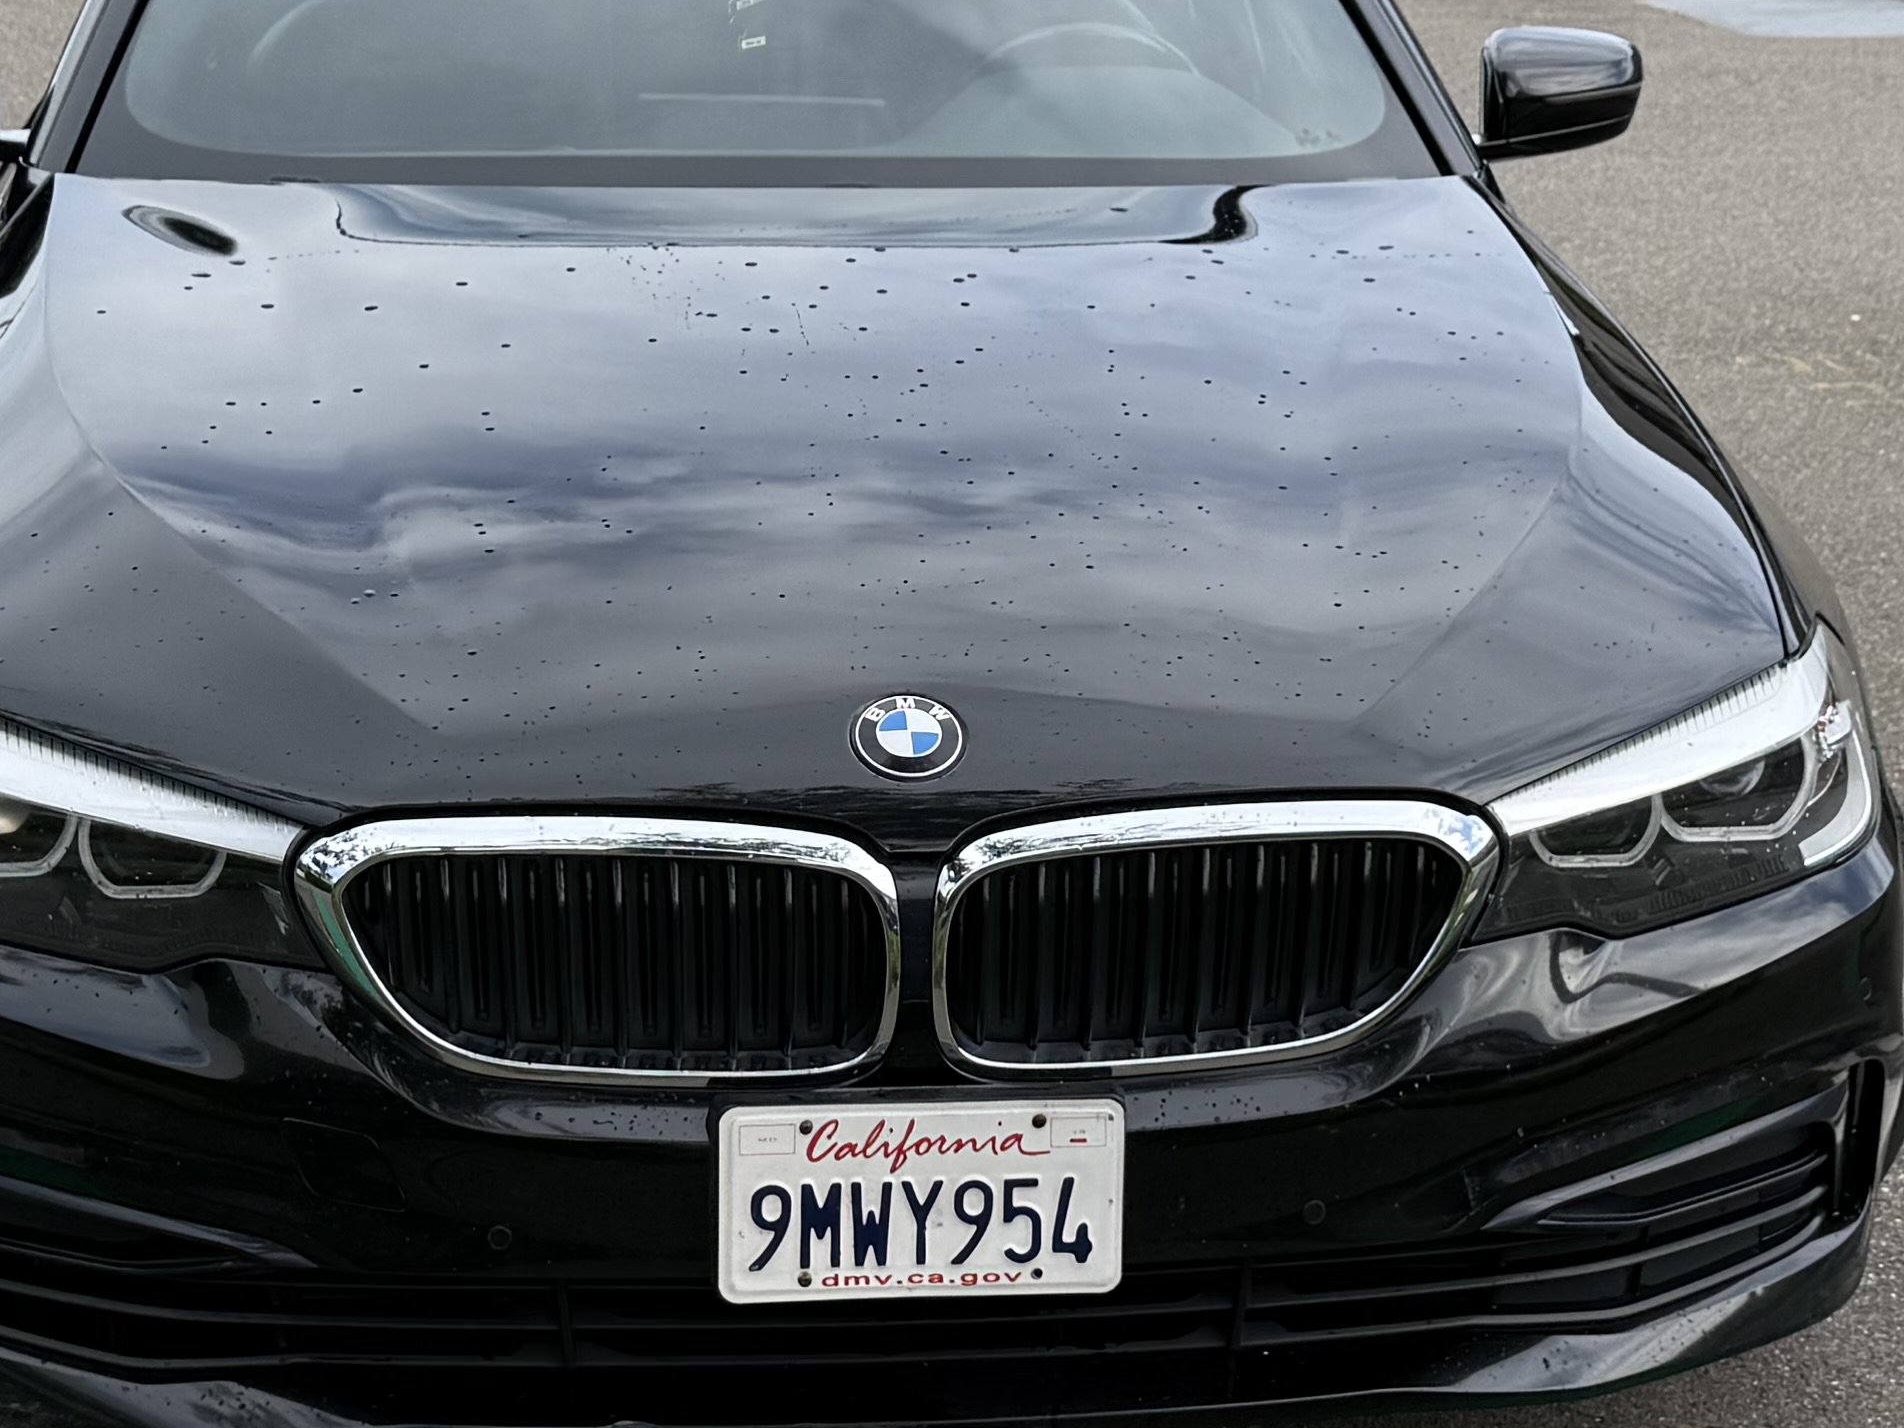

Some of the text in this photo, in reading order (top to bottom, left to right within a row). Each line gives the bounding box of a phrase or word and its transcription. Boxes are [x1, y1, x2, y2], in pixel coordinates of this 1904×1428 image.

[864, 697, 951, 722] BMW
[807, 1117, 1051, 1174] California
[748, 1176, 1094, 1273] 9MWY954
[821, 1271, 1024, 1288] dmv.ca.gov
